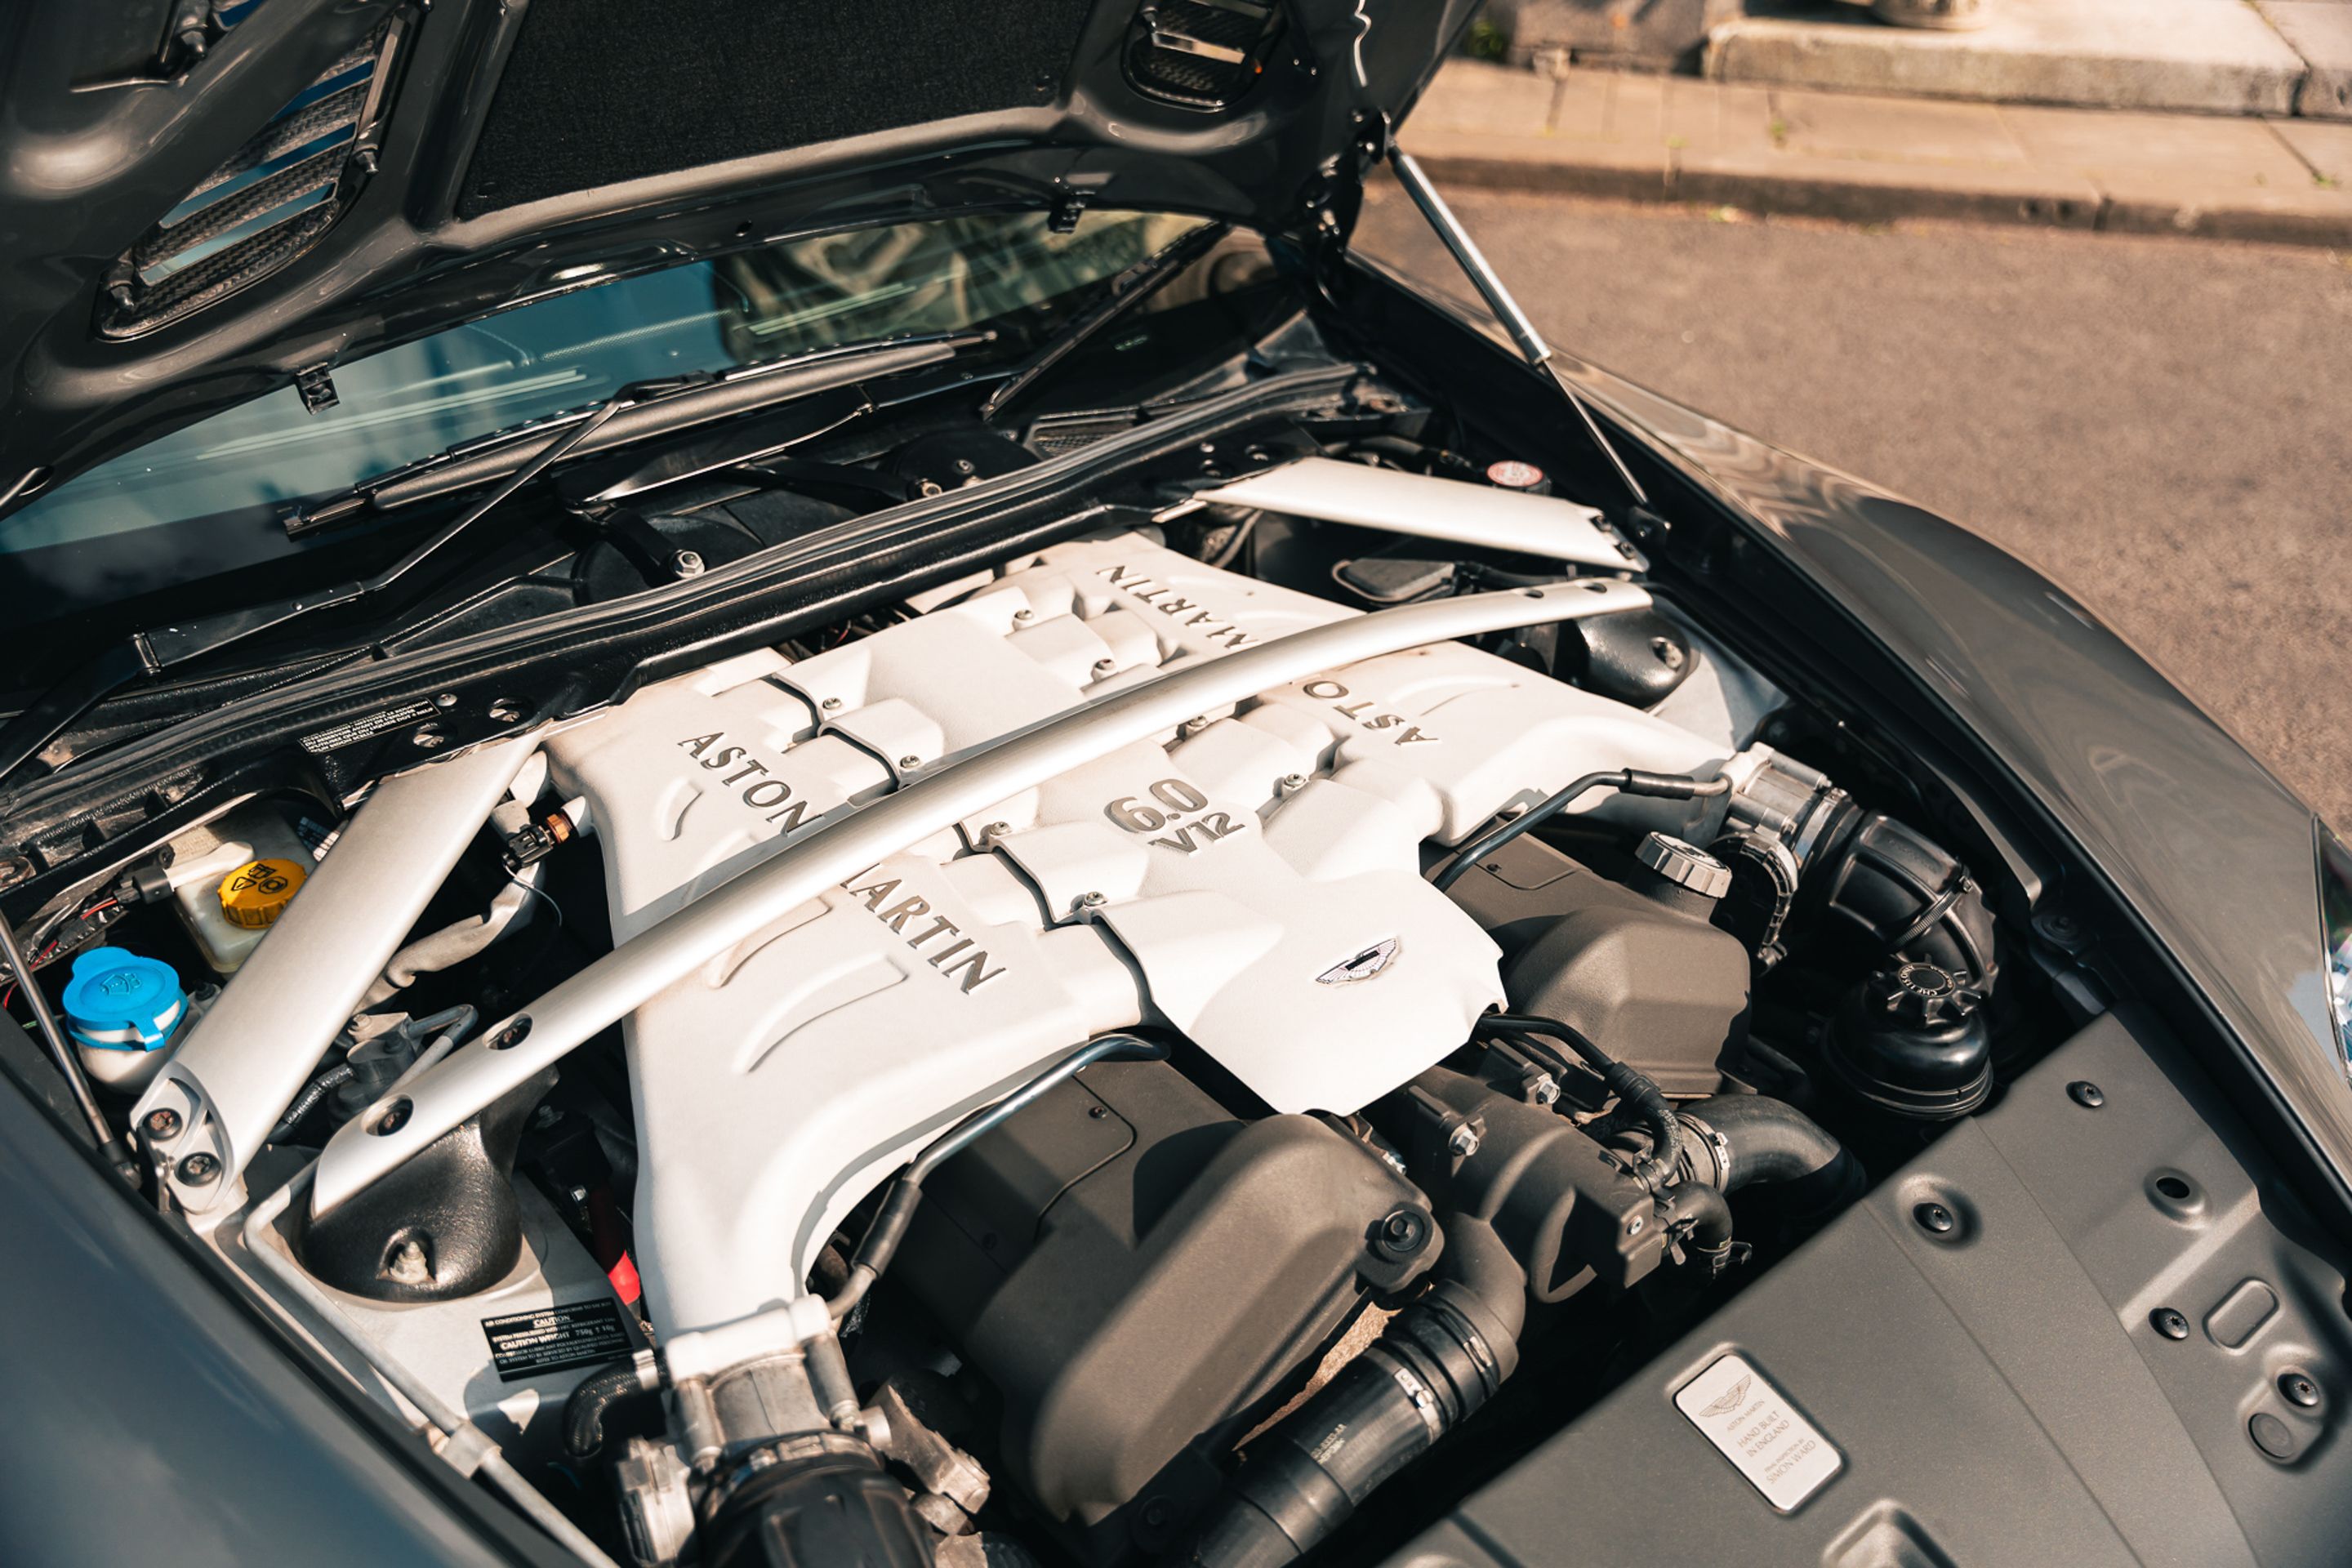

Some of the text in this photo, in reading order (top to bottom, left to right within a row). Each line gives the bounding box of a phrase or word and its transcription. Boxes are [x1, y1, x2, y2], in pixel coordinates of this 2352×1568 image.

[1097, 565, 1261, 649] MARTIN
[1289, 676, 1442, 745] ASTO
[678, 732, 823, 837] ASTON
[1147, 812, 1246, 856] V12
[532, 1315, 571, 1328] CAUTION
[500, 1337, 538, 1351] CAUTION
[1726, 1398, 1765, 1432] ASTON MARTIN
[1737, 1410, 1780, 1448] HAND BUILT
[1746, 1419, 1790, 1458] IN ENGLAND
[1766, 1440, 1817, 1485] SIMON WARD
